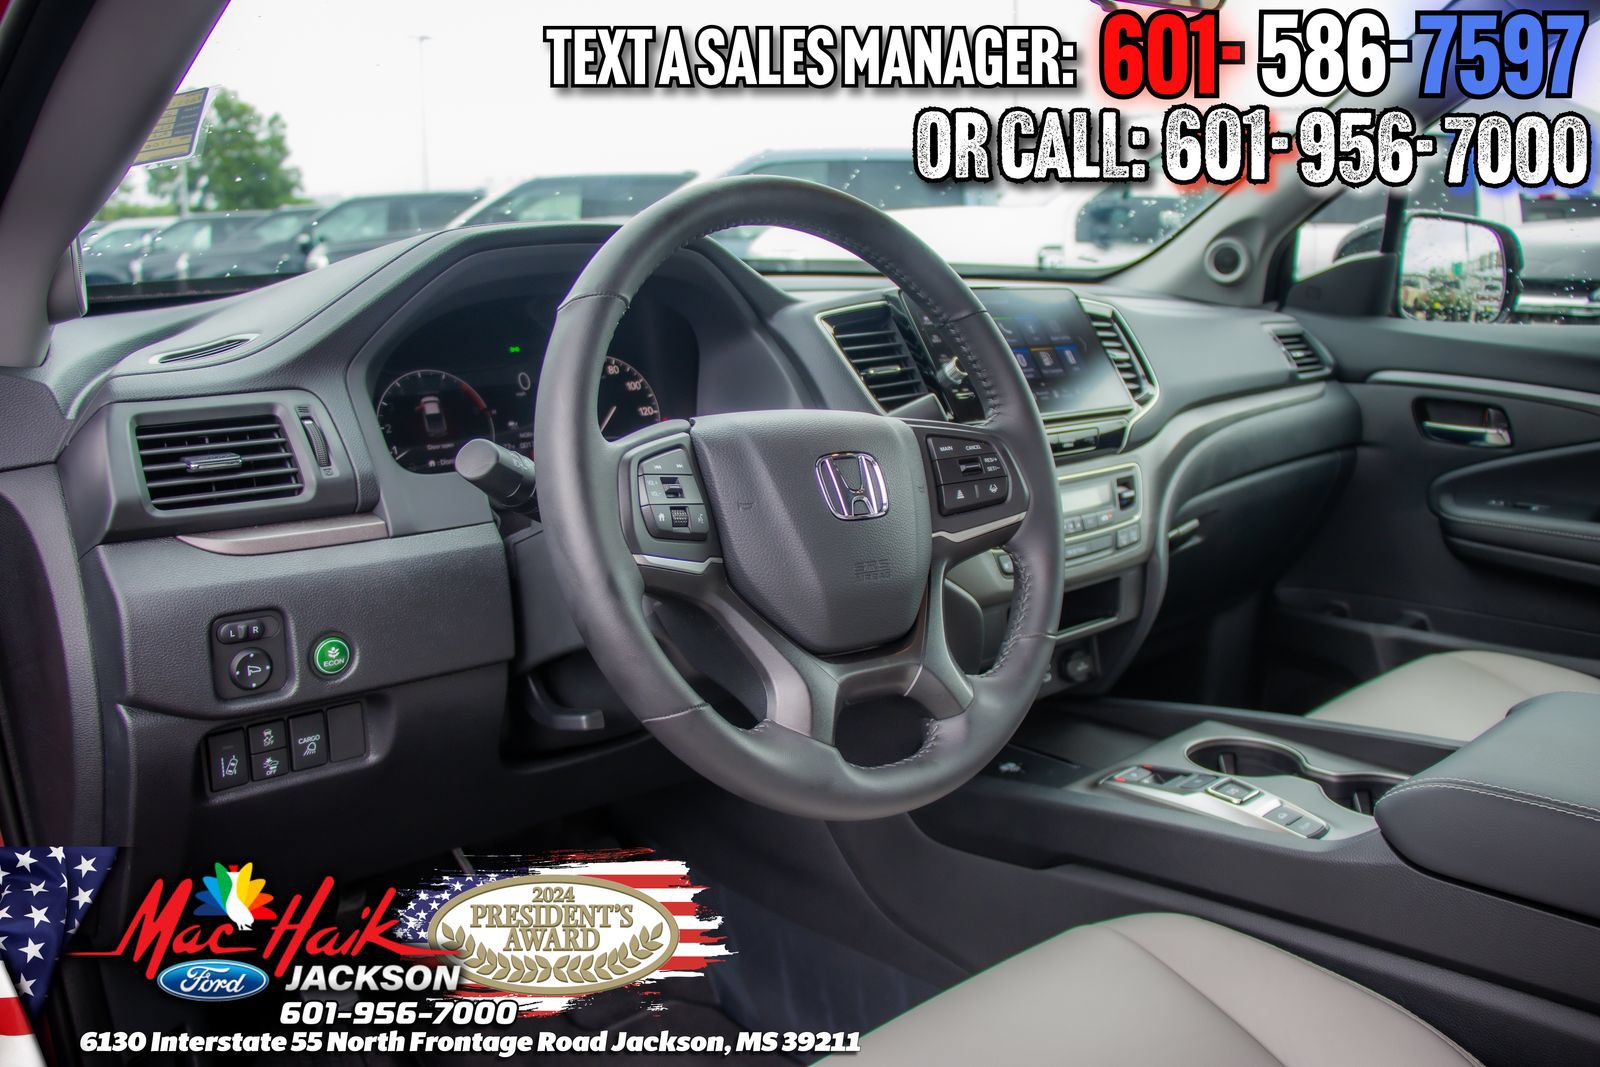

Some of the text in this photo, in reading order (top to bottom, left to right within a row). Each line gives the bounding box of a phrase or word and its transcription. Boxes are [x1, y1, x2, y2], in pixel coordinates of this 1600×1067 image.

[608, 365, 620, 375] 80
[625, 381, 642, 390] 100
[639, 406, 655, 416] 120
[229, 626, 259, 638] L R
[323, 657, 345, 668] ECON
[298, 734, 321, 745] CARGO
